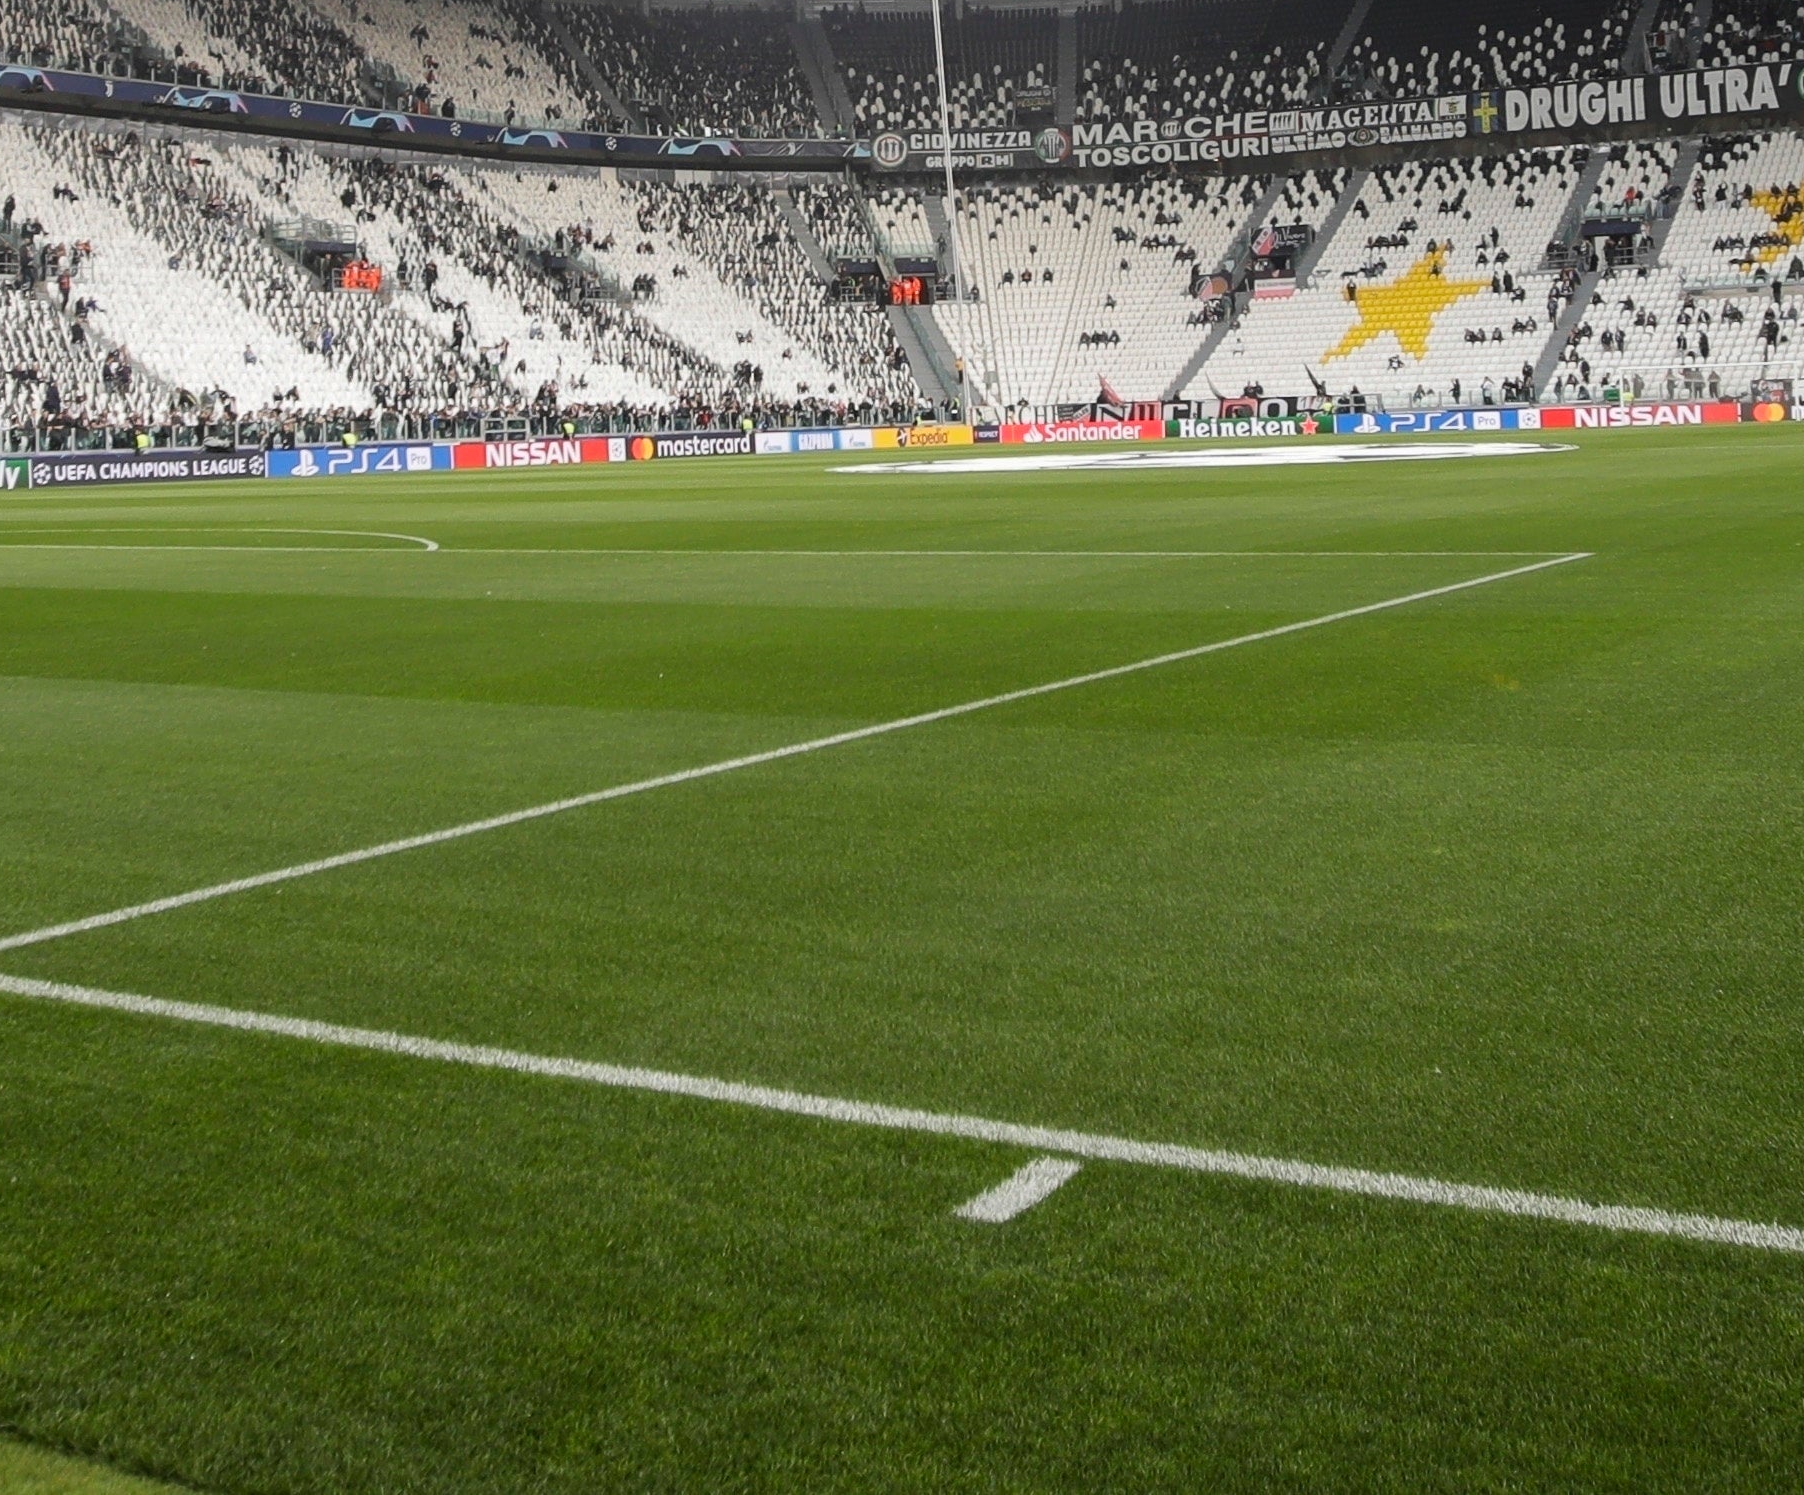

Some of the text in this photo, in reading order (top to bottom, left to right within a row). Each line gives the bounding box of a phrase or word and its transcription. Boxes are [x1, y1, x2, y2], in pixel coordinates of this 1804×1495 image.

[1504, 78, 1645, 132] DRUGHI
[1660, 63, 1791, 117] ULTRA'
[1300, 102, 1432, 132] MAGENTA
[910, 131, 1031, 150] GIOVINEZZA
[1073, 137, 1268, 167] TOSCOLIGURI
[1179, 417, 1297, 438] Heineken
[1391, 412, 1496, 433] PS4 Pro
[1574, 405, 1702, 428] NISSAN
[910, 429, 948, 446] Expedia
[1044, 423, 1142, 442] Santander
[485, 439, 581, 468] NISSAN
[657, 435, 751, 459] mastercard
[54, 456, 247, 482] UEFA CHAMPIONS LEAGUE
[327, 446, 429, 474] PS4 Pro
